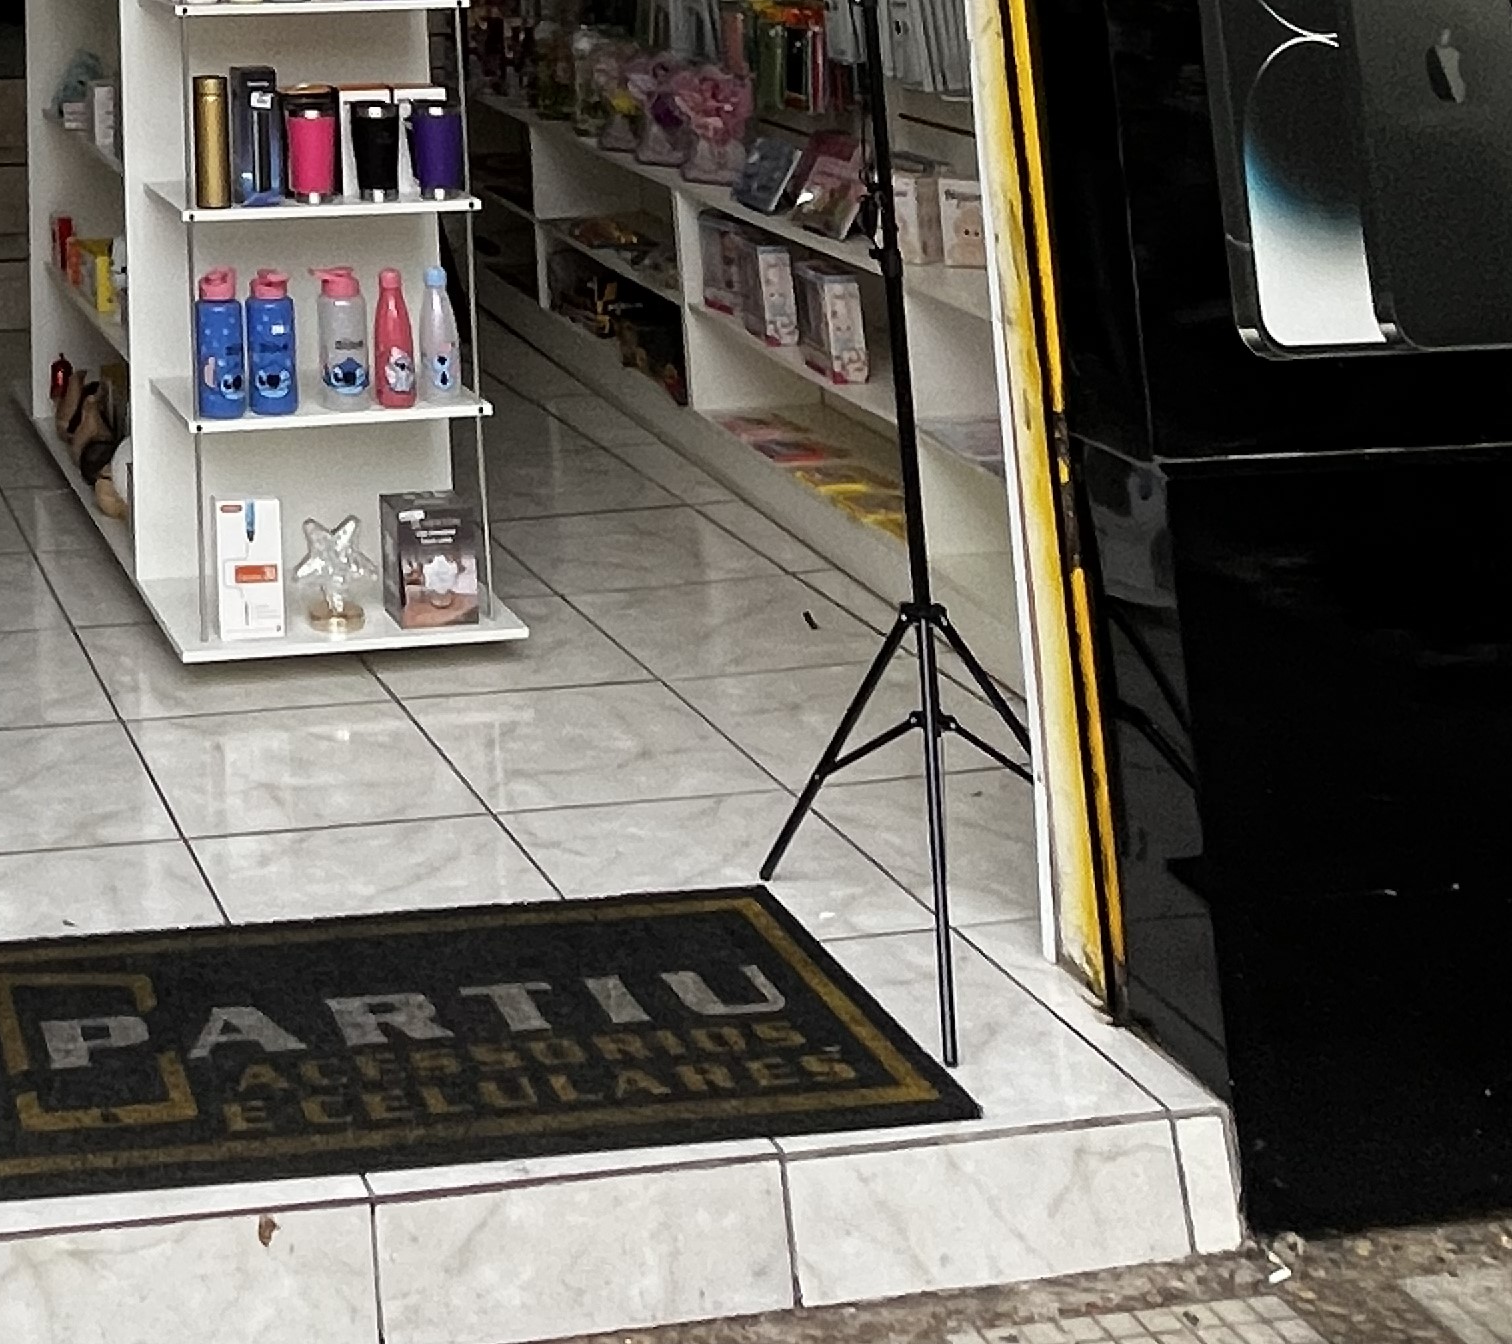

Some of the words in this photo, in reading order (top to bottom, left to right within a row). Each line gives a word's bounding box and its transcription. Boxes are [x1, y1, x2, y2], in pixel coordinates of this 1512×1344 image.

[39, 963, 787, 1070] PARTIU
[224, 1099, 275, 1134] E
[300, 1054, 857, 1126] CELULARES
